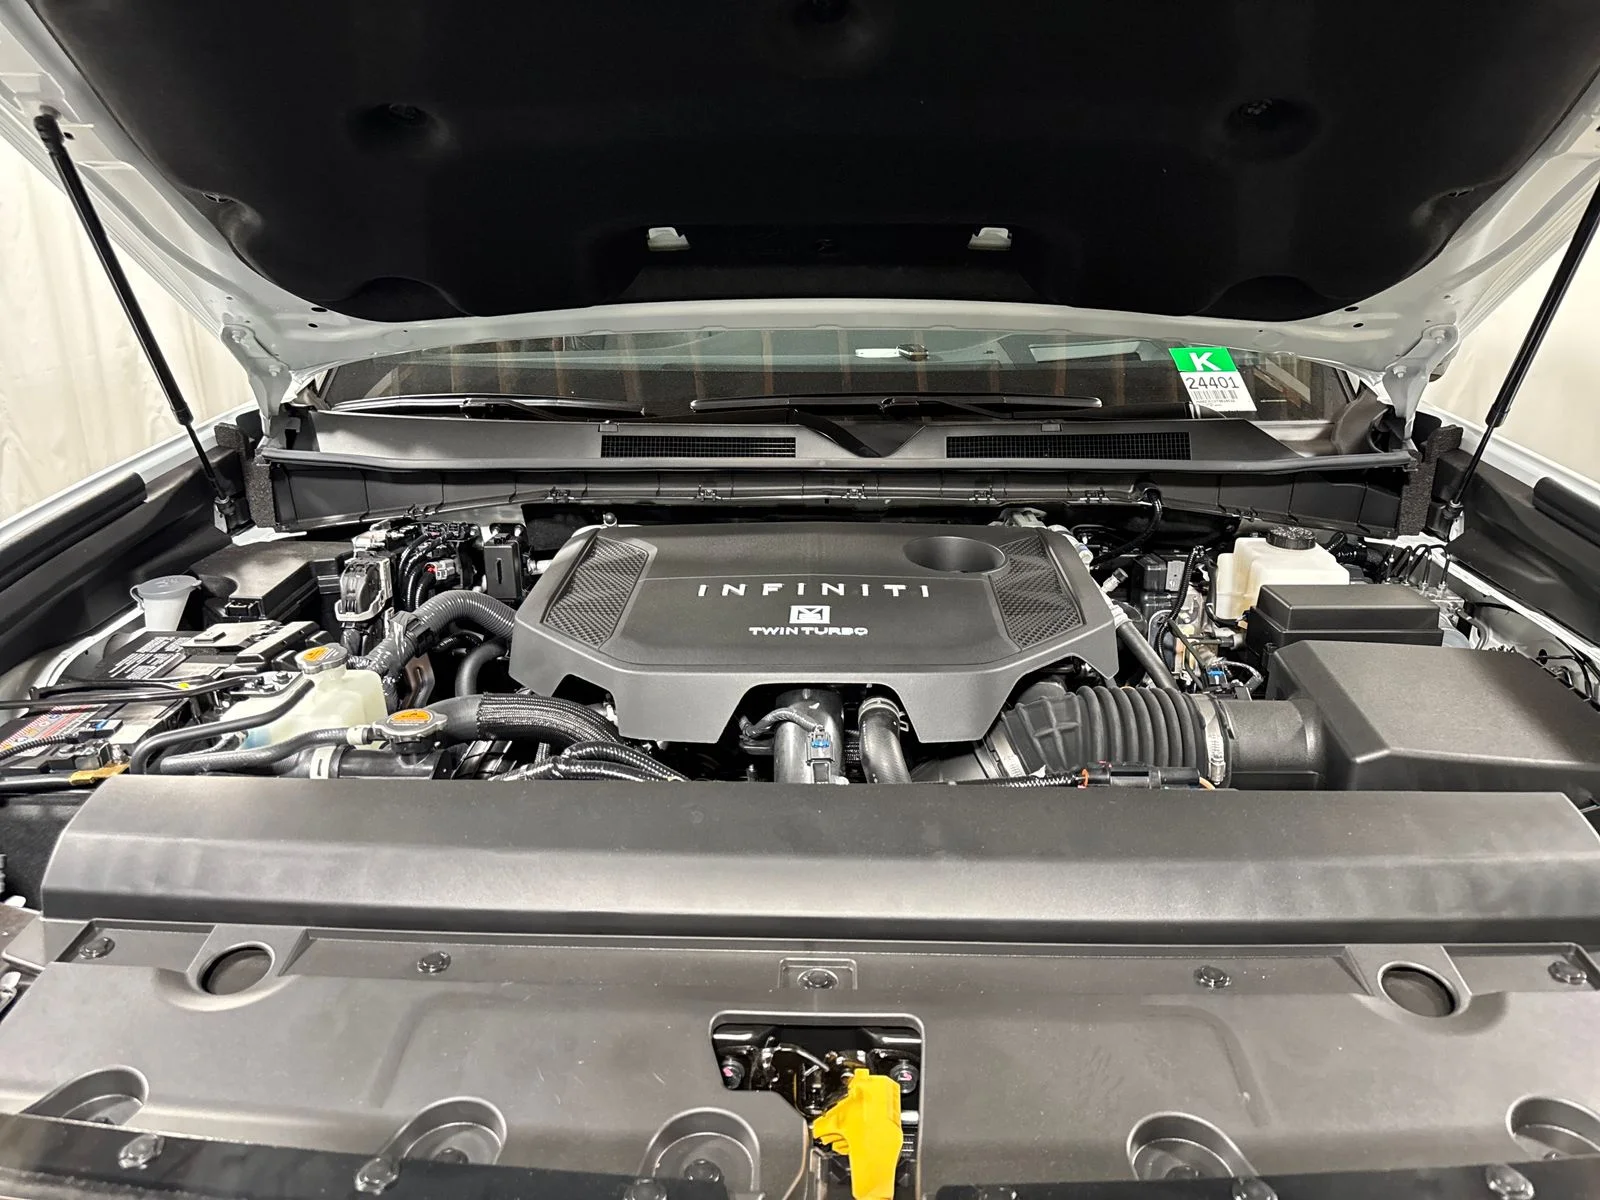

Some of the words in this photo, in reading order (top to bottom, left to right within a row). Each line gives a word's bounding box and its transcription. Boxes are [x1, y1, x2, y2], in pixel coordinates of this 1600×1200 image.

[1189, 351, 1222, 371] K
[1185, 376, 1240, 390] 24401
[697, 582, 930, 598] INFINITI
